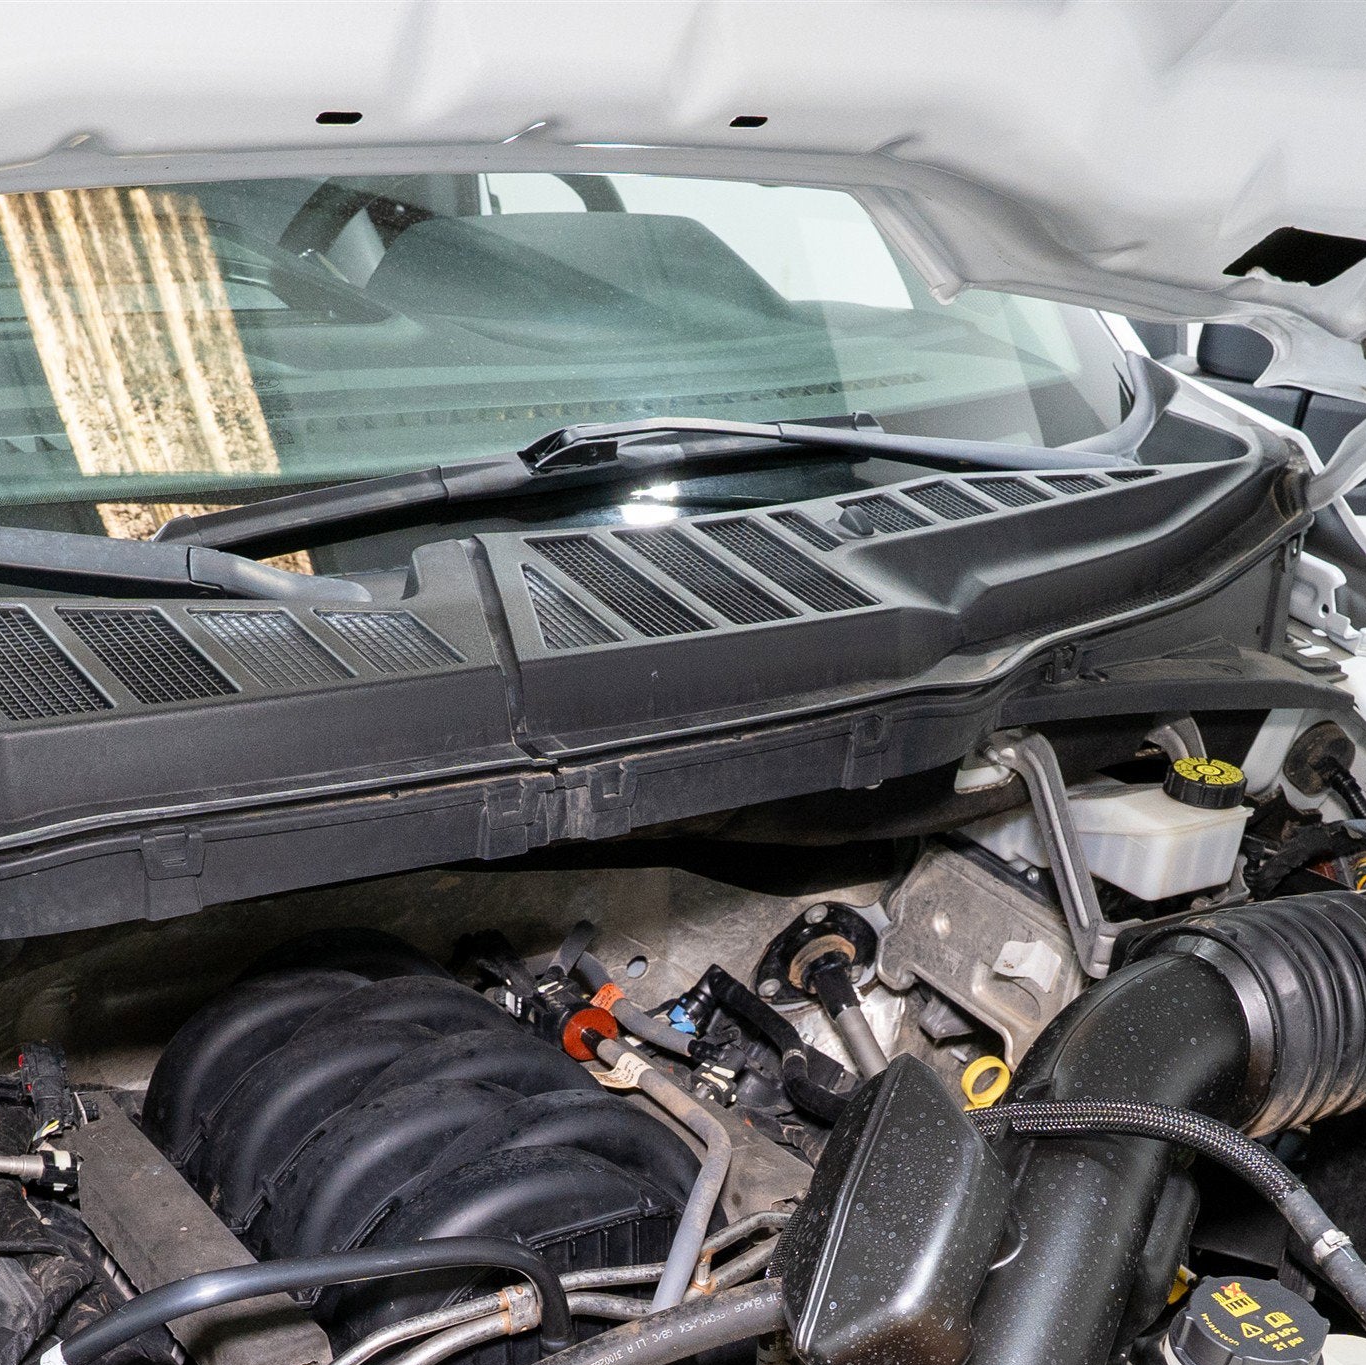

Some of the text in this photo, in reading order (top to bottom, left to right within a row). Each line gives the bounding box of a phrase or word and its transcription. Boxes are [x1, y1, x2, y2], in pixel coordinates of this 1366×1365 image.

[1278, 1326, 1298, 1340] kPa
[1273, 1336, 1304, 1351] 21 psi
